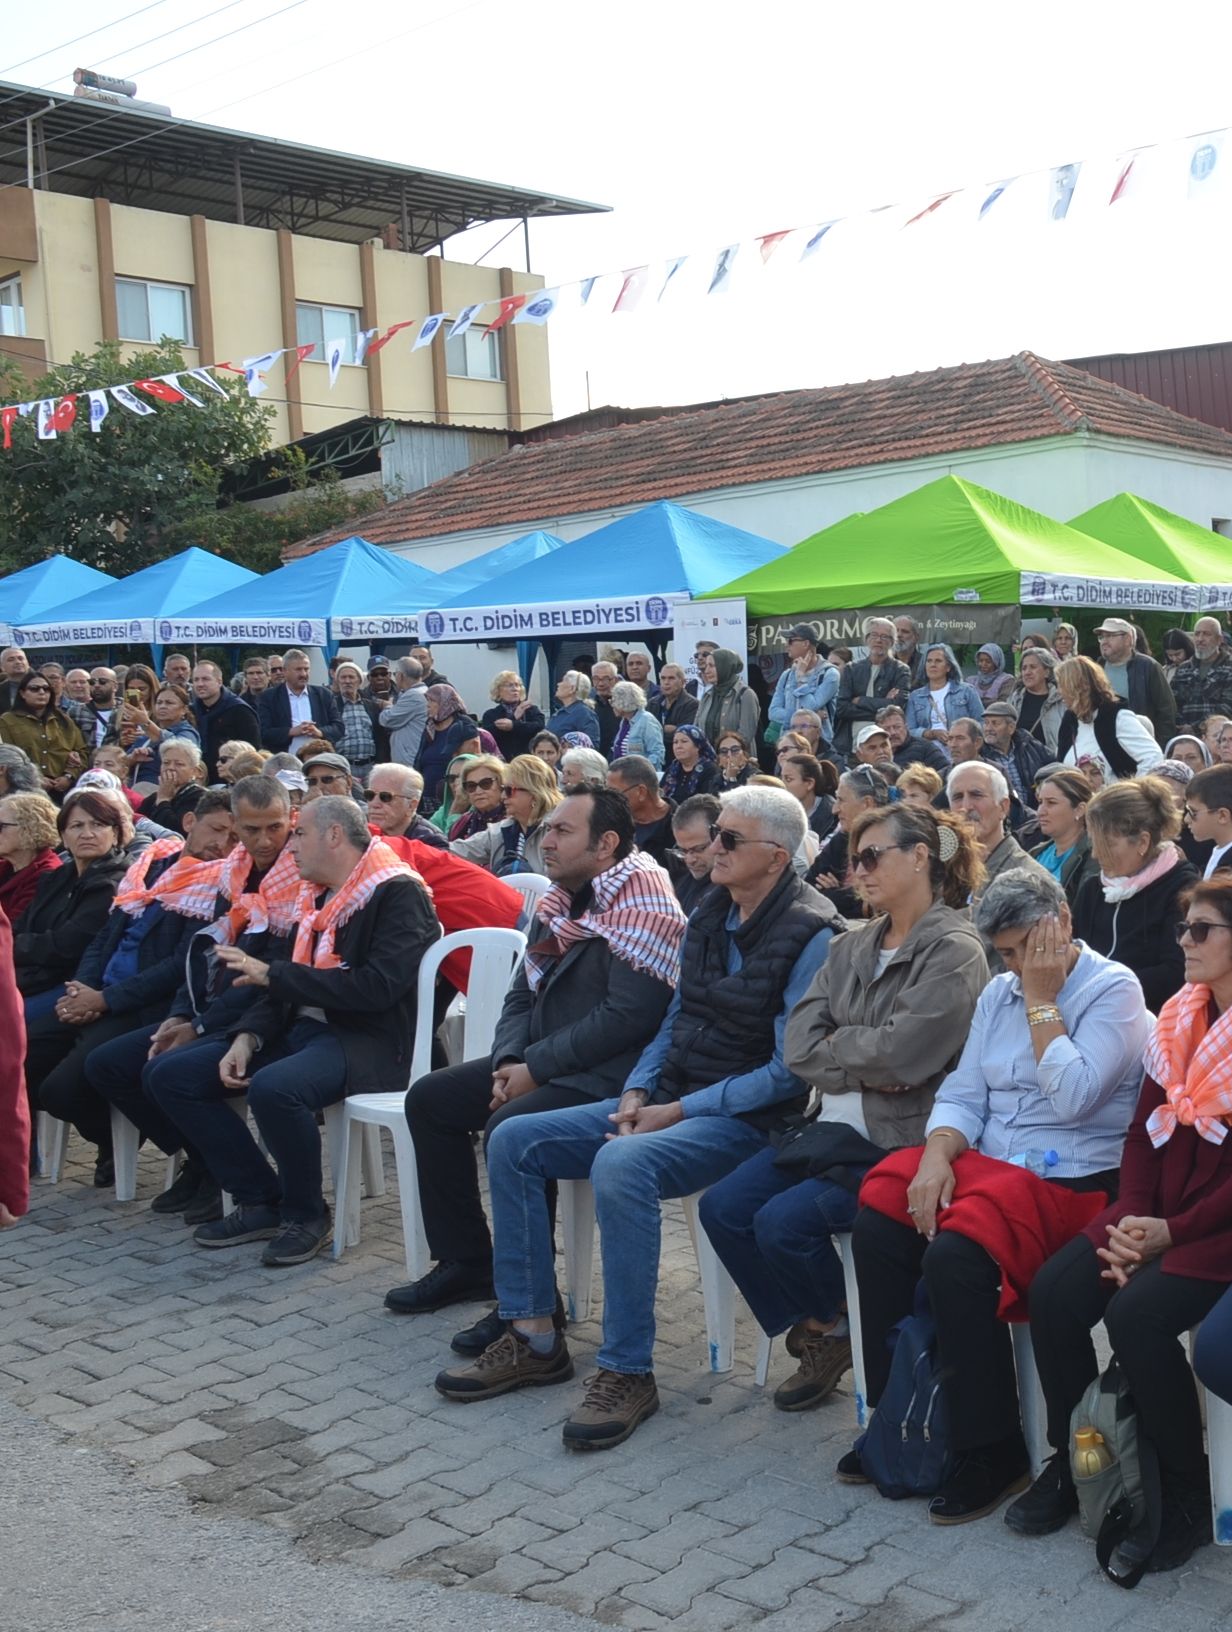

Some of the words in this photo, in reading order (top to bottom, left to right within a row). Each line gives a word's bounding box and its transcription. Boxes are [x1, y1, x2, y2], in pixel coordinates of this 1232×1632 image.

[1051, 584, 1073, 601] T.C.
[1077, 580, 1112, 603] DİDİM
[1116, 585, 1177, 606] BELEDİYESİ
[449, 616, 479, 633] T.C.
[483, 609, 534, 631] DİDİM
[539, 600, 641, 628] BELEDİYESİ
[25, 631, 41, 643] T.C.
[43, 626, 70, 642] DİDİM
[73, 623, 128, 640] BELEDİYESİ
[174, 626, 194, 638] T.C.
[196, 622, 228, 638] DİDİM
[231, 621, 295, 639] BELEDİYESİ
[357, 621, 378, 634] T.C.
